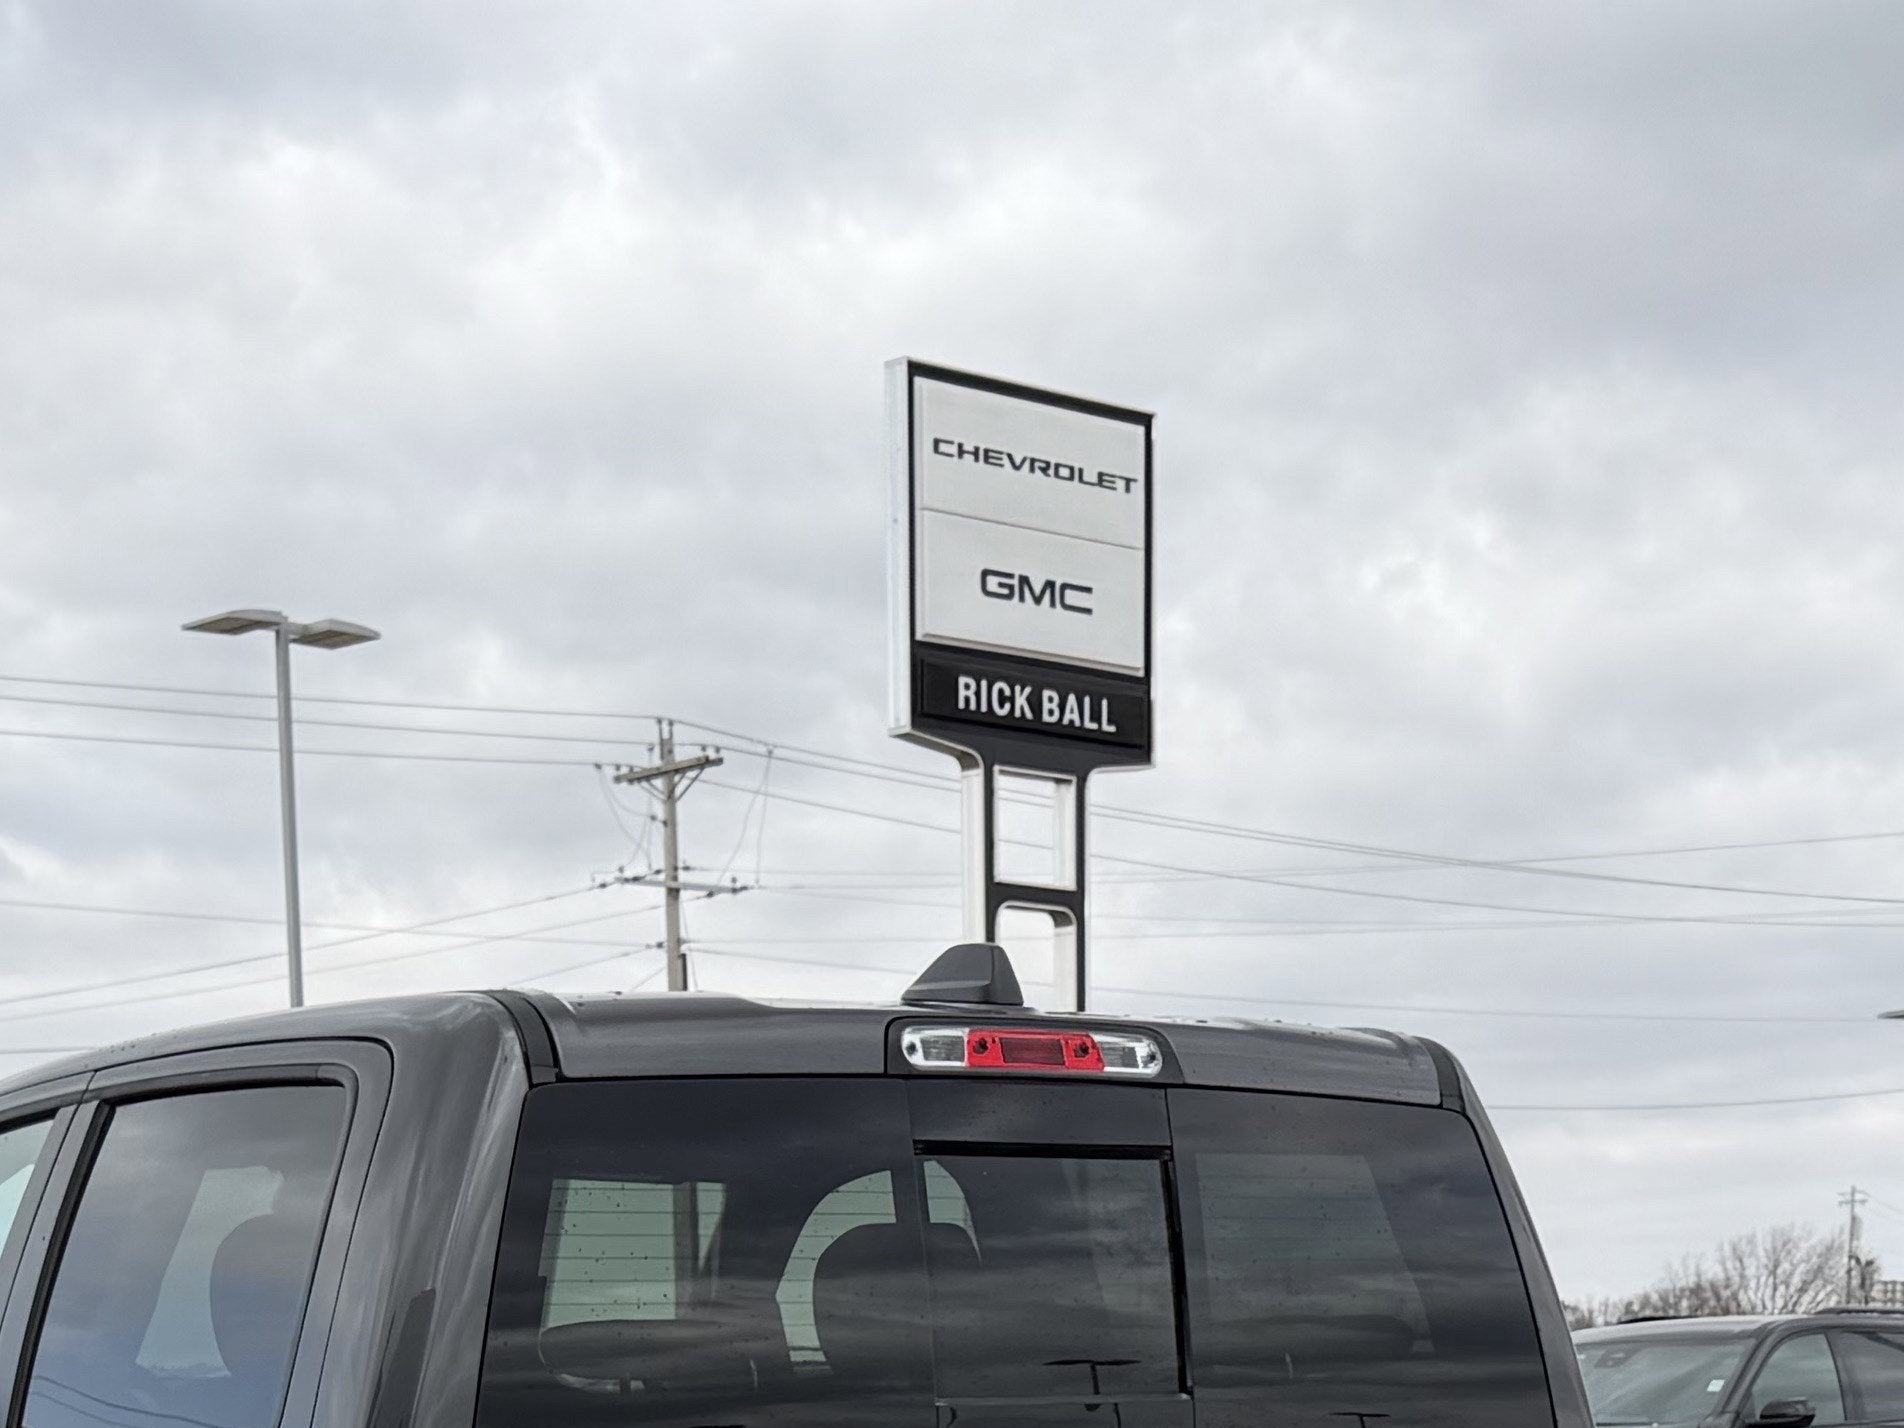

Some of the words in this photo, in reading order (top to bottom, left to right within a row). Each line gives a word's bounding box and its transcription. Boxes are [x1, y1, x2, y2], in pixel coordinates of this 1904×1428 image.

[932, 437, 1138, 494] CHEVROLET
[980, 567, 1094, 616] GMC
[957, 674, 1034, 721] RICK
[1041, 687, 1117, 734] BALL
